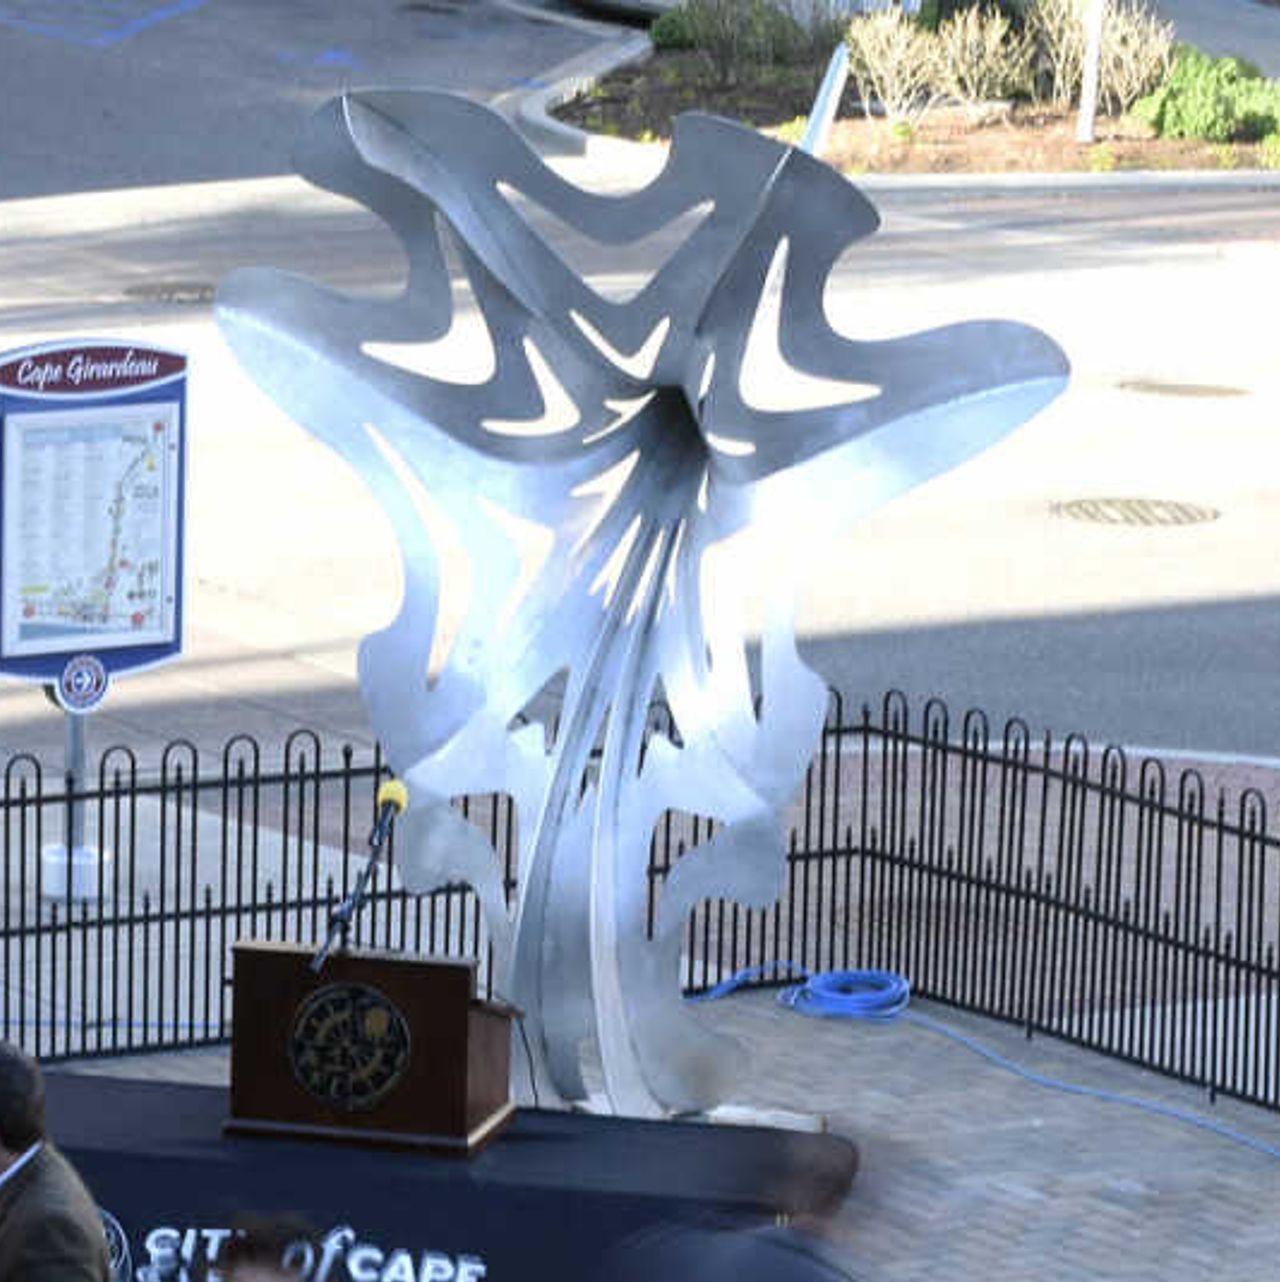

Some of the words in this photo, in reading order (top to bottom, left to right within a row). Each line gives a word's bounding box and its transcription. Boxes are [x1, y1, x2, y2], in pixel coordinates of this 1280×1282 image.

[17, 359, 62, 392] Cape
[66, 348, 159, 385] Girardeau
[145, 1228, 250, 1262] CIT
